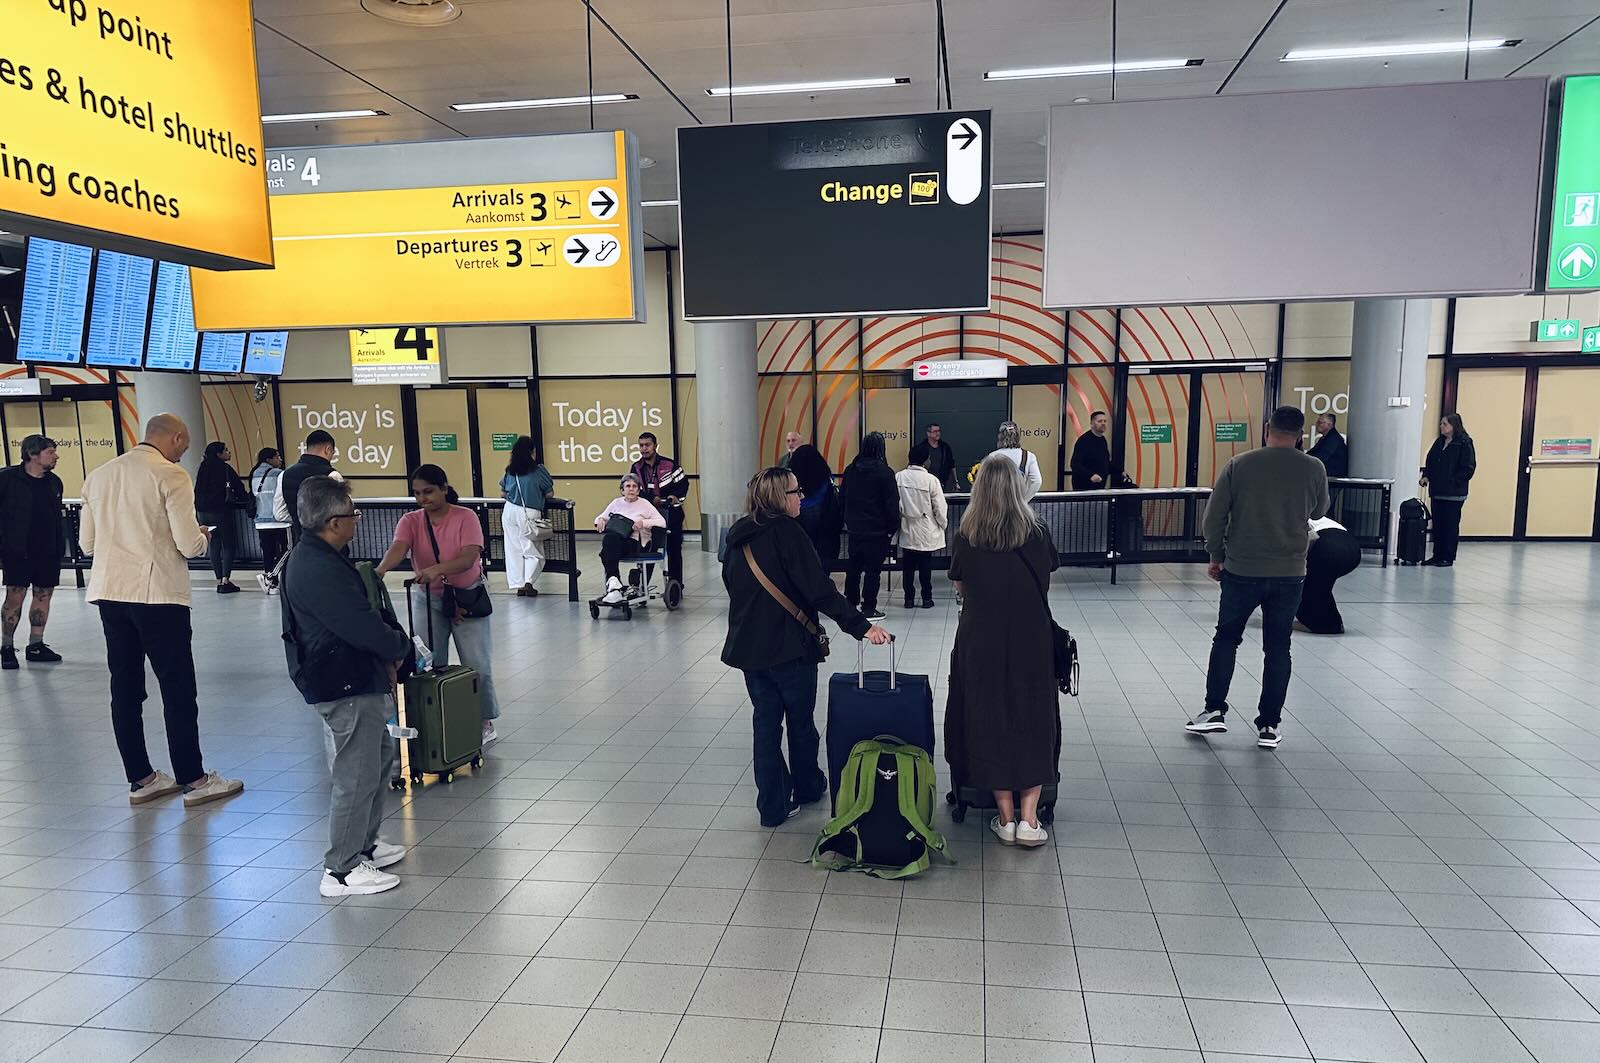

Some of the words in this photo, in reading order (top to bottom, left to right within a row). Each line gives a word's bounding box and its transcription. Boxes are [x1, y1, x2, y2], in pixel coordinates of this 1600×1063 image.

[98, 7, 173, 60] point
[0, 57, 33, 91] es
[46, 68, 70, 104] &
[78, 76, 154, 132] hotel
[163, 112, 257, 167] shuttles
[0, 143, 56, 197] ing
[67, 171, 180, 219] coaches
[301, 157, 321, 186] 4
[452, 189, 524, 208] Arrivals
[530, 192, 547, 222] 3
[820, 181, 903, 205] Change
[466, 211, 525, 224] Aankomst
[396, 239, 498, 258] Departures
[506, 239, 523, 268] 3
[455, 257, 499, 269] Vertrek
[394, 326, 433, 360] 4
[291, 403, 367, 434] Today
[375, 404, 395, 428] is
[552, 401, 634, 433] Today
[641, 401, 662, 427] is
[55, 439, 72, 448] oday
[100, 439, 113, 448] day
[882, 430, 897, 440] day
[900, 430, 907, 438] is
[1020, 427, 1031, 436] he
[1034, 428, 1051, 438] day
[298, 440, 339, 463] te
[348, 438, 393, 469] day
[559, 437, 603, 463] the
[611, 437, 660, 463] da
